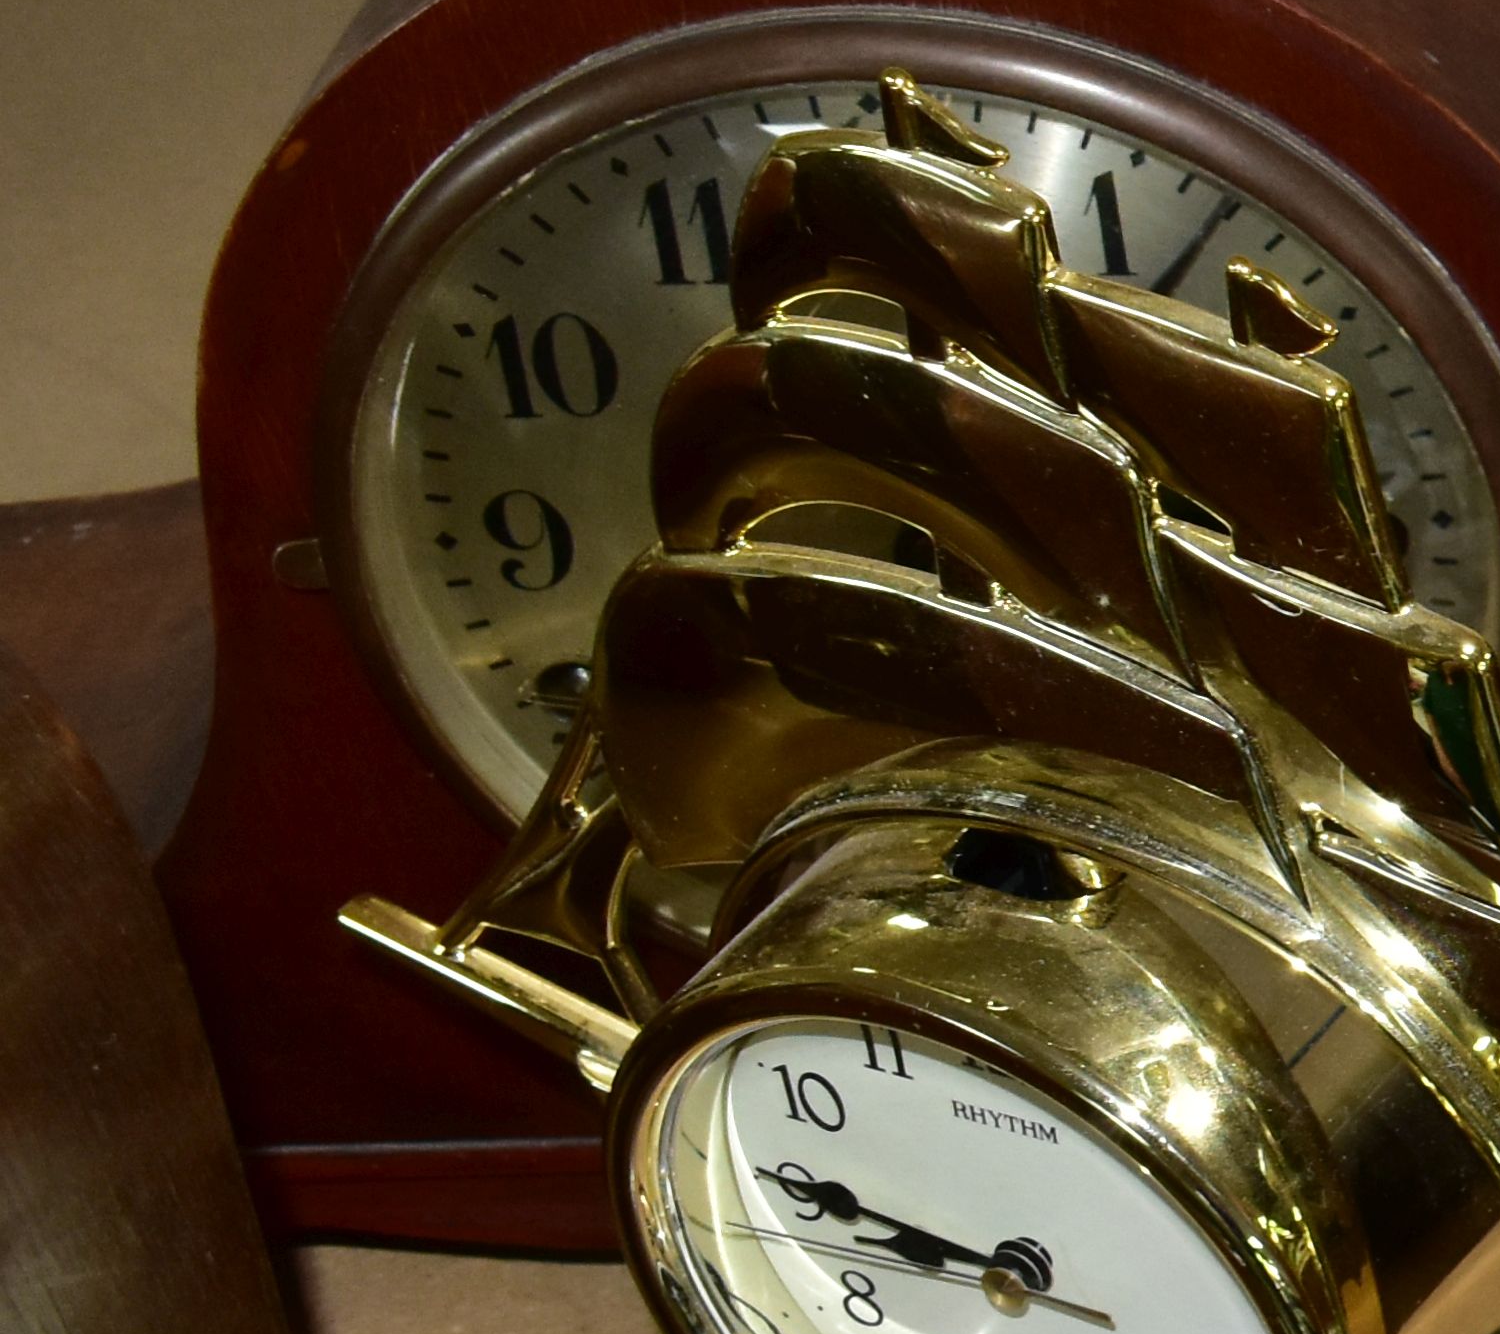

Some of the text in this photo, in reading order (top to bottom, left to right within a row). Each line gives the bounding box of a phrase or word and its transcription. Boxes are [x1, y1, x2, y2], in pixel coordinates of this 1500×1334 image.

[639, 173, 732, 287] 11
[1085, 169, 1134, 278] 1
[482, 311, 620, 420] 10
[482, 489, 574, 594] 9
[769, 1062, 846, 1133] 10
[951, 1099, 1060, 1145] RHYTHM
[840, 1270, 885, 1327] 8
